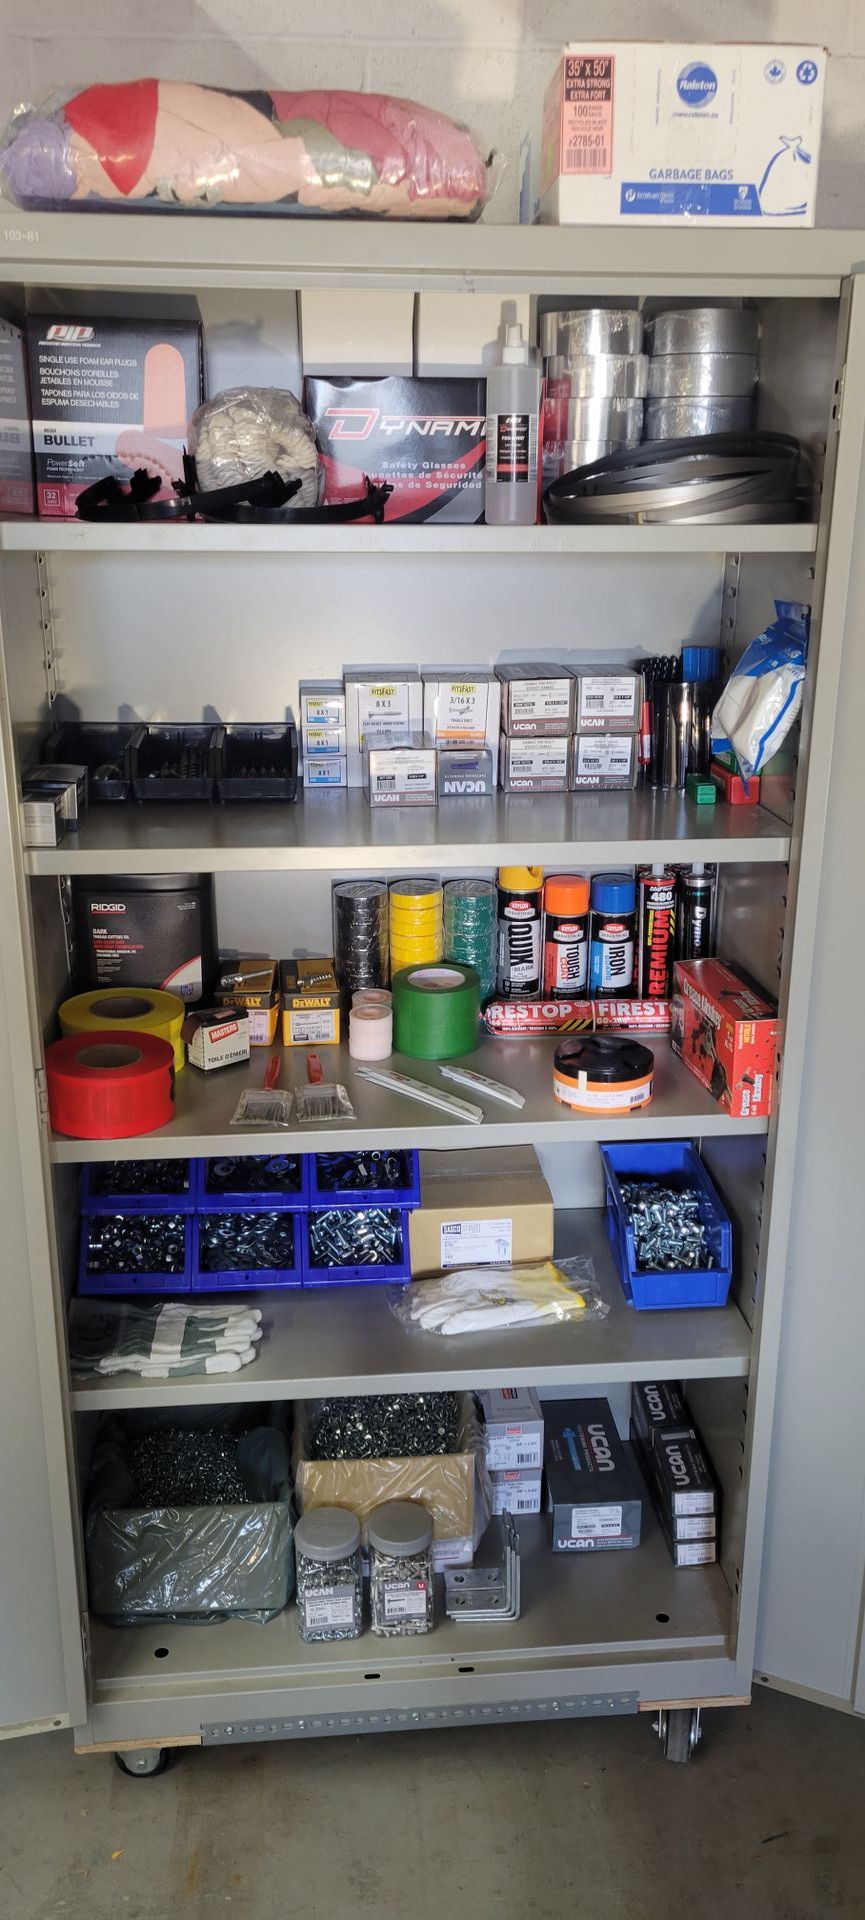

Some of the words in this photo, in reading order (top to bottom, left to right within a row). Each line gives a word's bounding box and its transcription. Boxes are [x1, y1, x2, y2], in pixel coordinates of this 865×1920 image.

[568, 60, 583, 76] 35"
[594, 60, 608, 76] 50"
[567, 79, 585, 88] EXTRA
[586, 79, 610, 88] STRONG
[571, 91, 589, 100] EXTRA
[590, 91, 606, 100] FORT
[574, 106, 588, 117] 100
[649, 169, 701, 180] GARBAGE
[705, 169, 734, 180] BAGS
[39, 356, 64, 364] SINGLE
[100, 358, 113, 366] EAR
[115, 359, 137, 367] PLUGS
[40, 368, 80, 376] BOUCHONS
[40, 377, 71, 385] JETABLES
[85, 379, 113, 387] MOUSSE
[41, 389, 72, 397] TAPONES
[44, 435, 95, 447] BULLET
[382, 462, 418, 470] Safety
[423, 462, 466, 470] Glasses
[425, 482, 482, 490] Seguridad
[581, 719, 604, 727] UCAN
[444, 781, 486, 793] UCAN
[374, 794, 399, 802] UCAN
[651, 892, 672, 901] 480
[692, 906, 707, 948] Dymo
[508, 924, 533, 967] QUIK
[649, 910, 670, 995] REMIUM
[566, 945, 580, 980] TOUGH
[609, 945, 625, 976] IRON
[560, 957, 568, 980] COAT
[491, 1004, 572, 1017] RESTOP
[598, 1002, 668, 1017] FIREST
[211, 1023, 238, 1040] MASTERS
[208, 1055, 223, 1063] TOILE
[305, 1588, 334, 1597] UCAN
